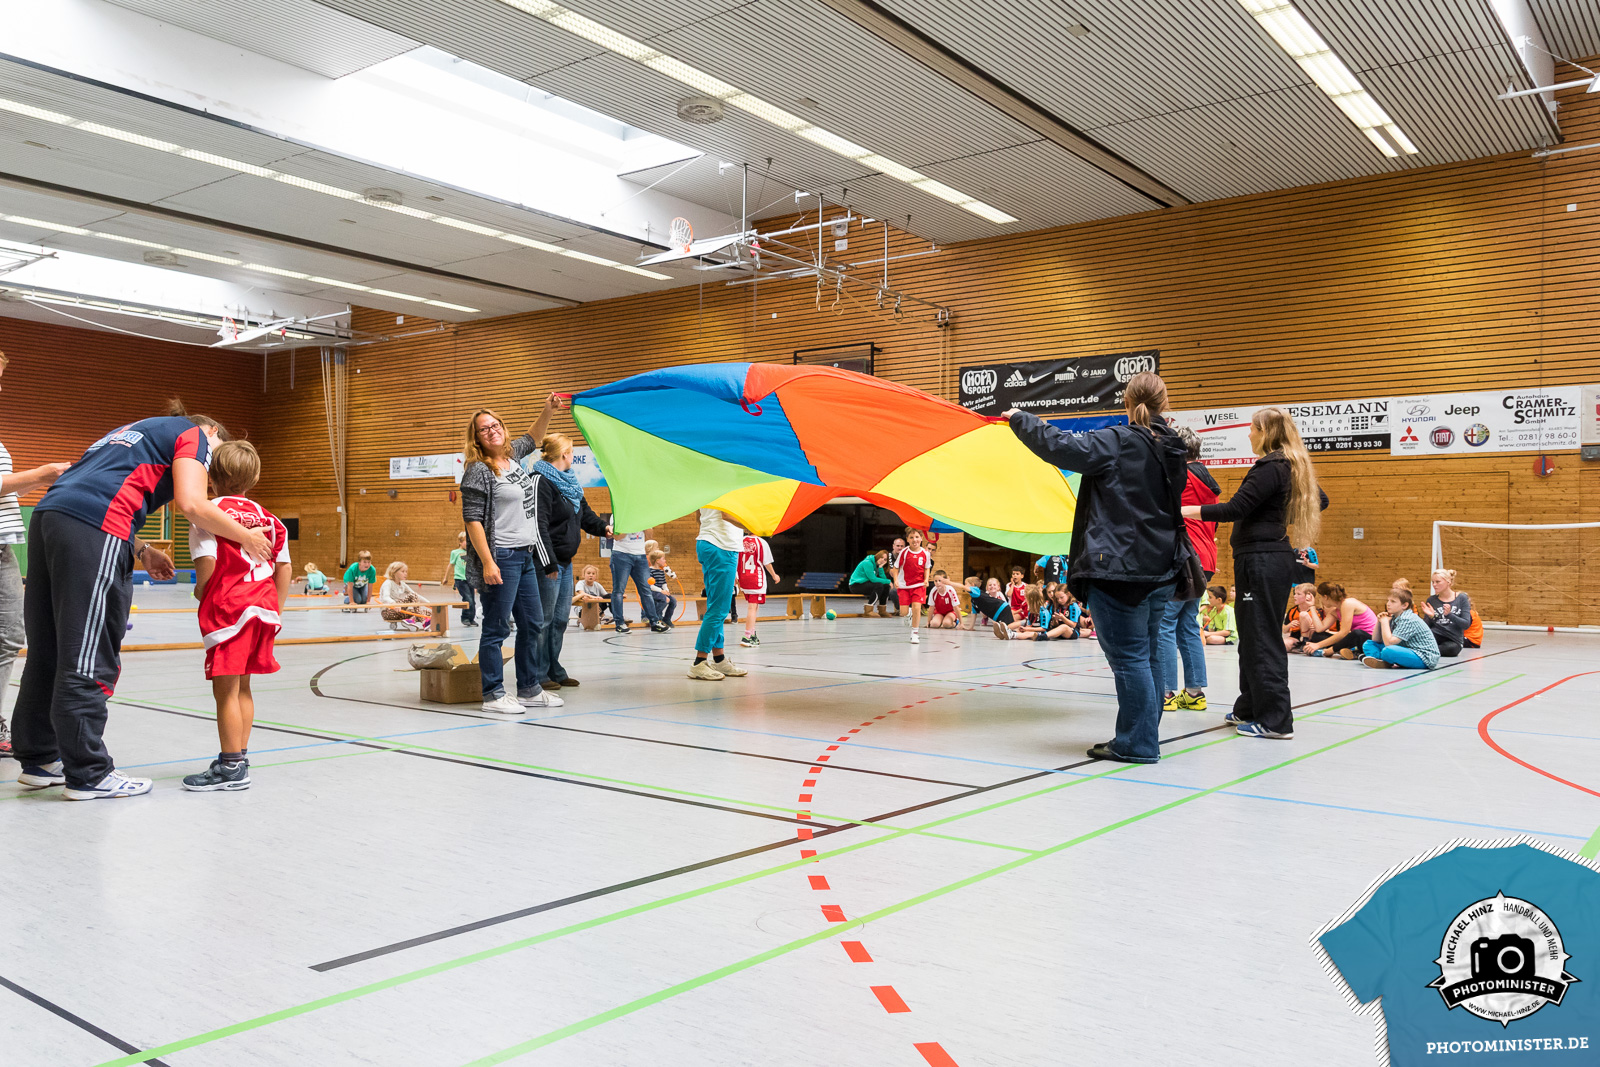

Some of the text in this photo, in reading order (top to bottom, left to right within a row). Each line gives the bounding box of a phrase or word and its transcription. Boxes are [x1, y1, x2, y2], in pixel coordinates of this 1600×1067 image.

[1055, 373, 1075, 381] PUMA
[968, 385, 992, 395] SPORT
[1004, 380, 1027, 388] adidas
[1011, 395, 1100, 408] www.ropa-sport.de
[1502, 395, 1568, 409] CRAMER-
[1286, 401, 1389, 418] ESEMANN
[1444, 404, 1481, 417] Jeep
[1513, 406, 1576, 424] SCHMITZ
[1204, 412, 1239, 426] WESEL
[1435, 432, 1450, 443] FIAT
[1325, 442, 1331, 450] &
[1498, 440, 1577, 448] www.cramer-schmitz.de
[572, 455, 586, 464] RKE
[742, 553, 756, 574] 14
[918, 556, 924, 566] 6
[1052, 562, 1060, 575] 3
